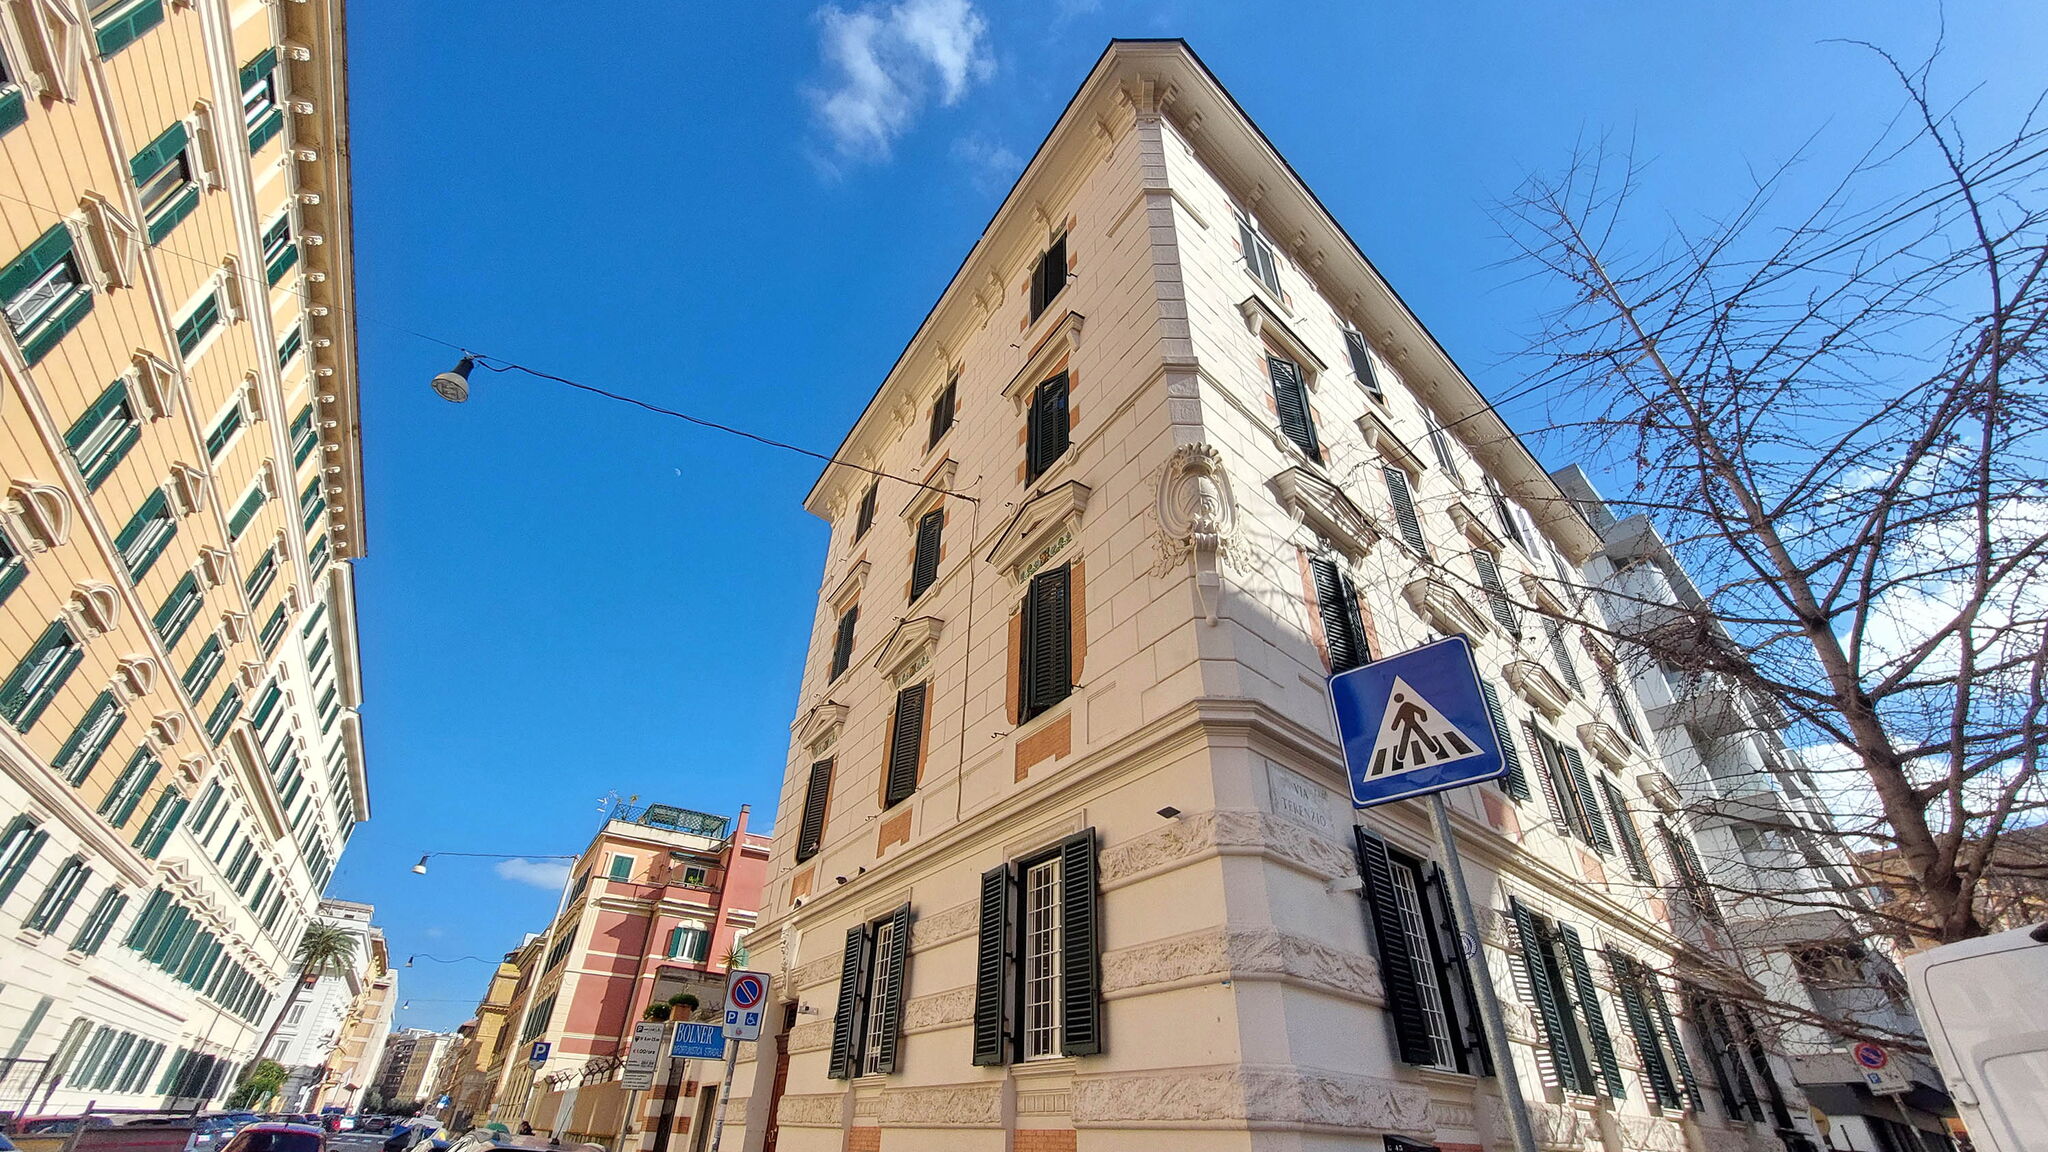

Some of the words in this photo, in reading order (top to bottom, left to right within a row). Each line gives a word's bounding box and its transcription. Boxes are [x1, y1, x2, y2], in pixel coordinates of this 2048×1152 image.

[1293, 783, 1309, 800] VIA
[1281, 797, 1327, 827] TERENZIO
[728, 1012, 736, 1023] P
[676, 1023, 714, 1045] BOLNER
[533, 1044, 547, 1059] P
